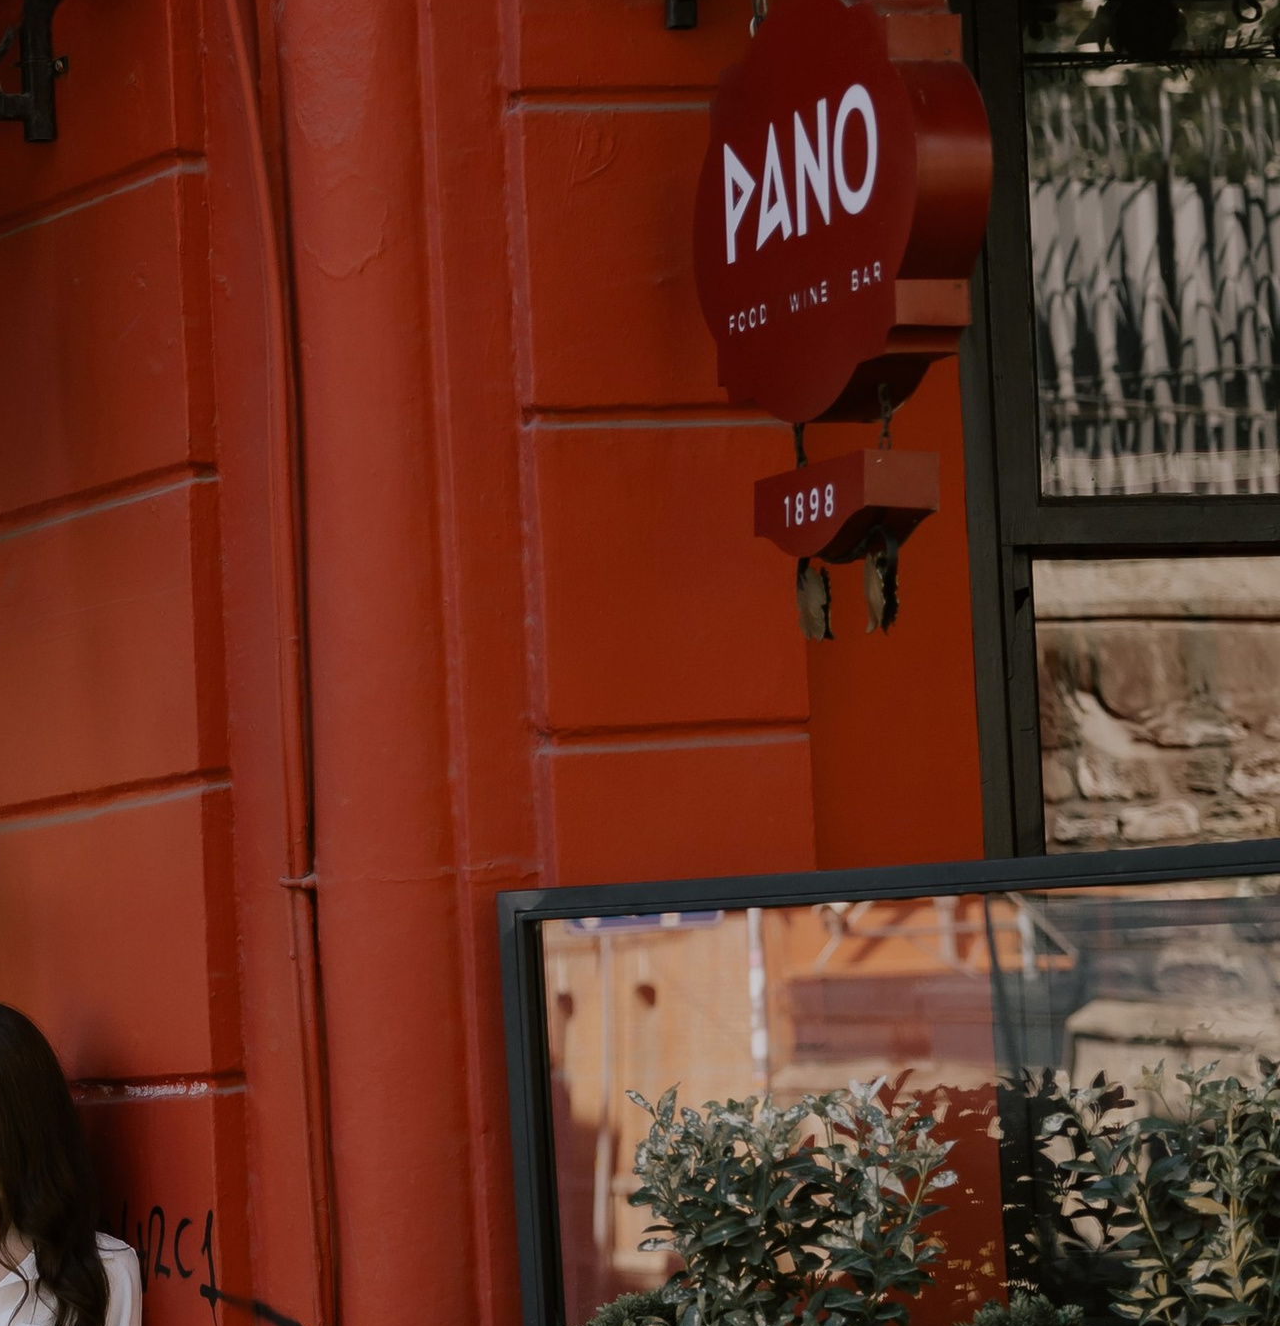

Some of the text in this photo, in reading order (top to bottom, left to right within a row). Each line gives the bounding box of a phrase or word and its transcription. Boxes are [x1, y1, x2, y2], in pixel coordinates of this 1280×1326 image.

[723, 83, 878, 265] PANO
[728, 261, 882, 336] FOOD WINE BAR
[784, 483, 834, 528] 1898
